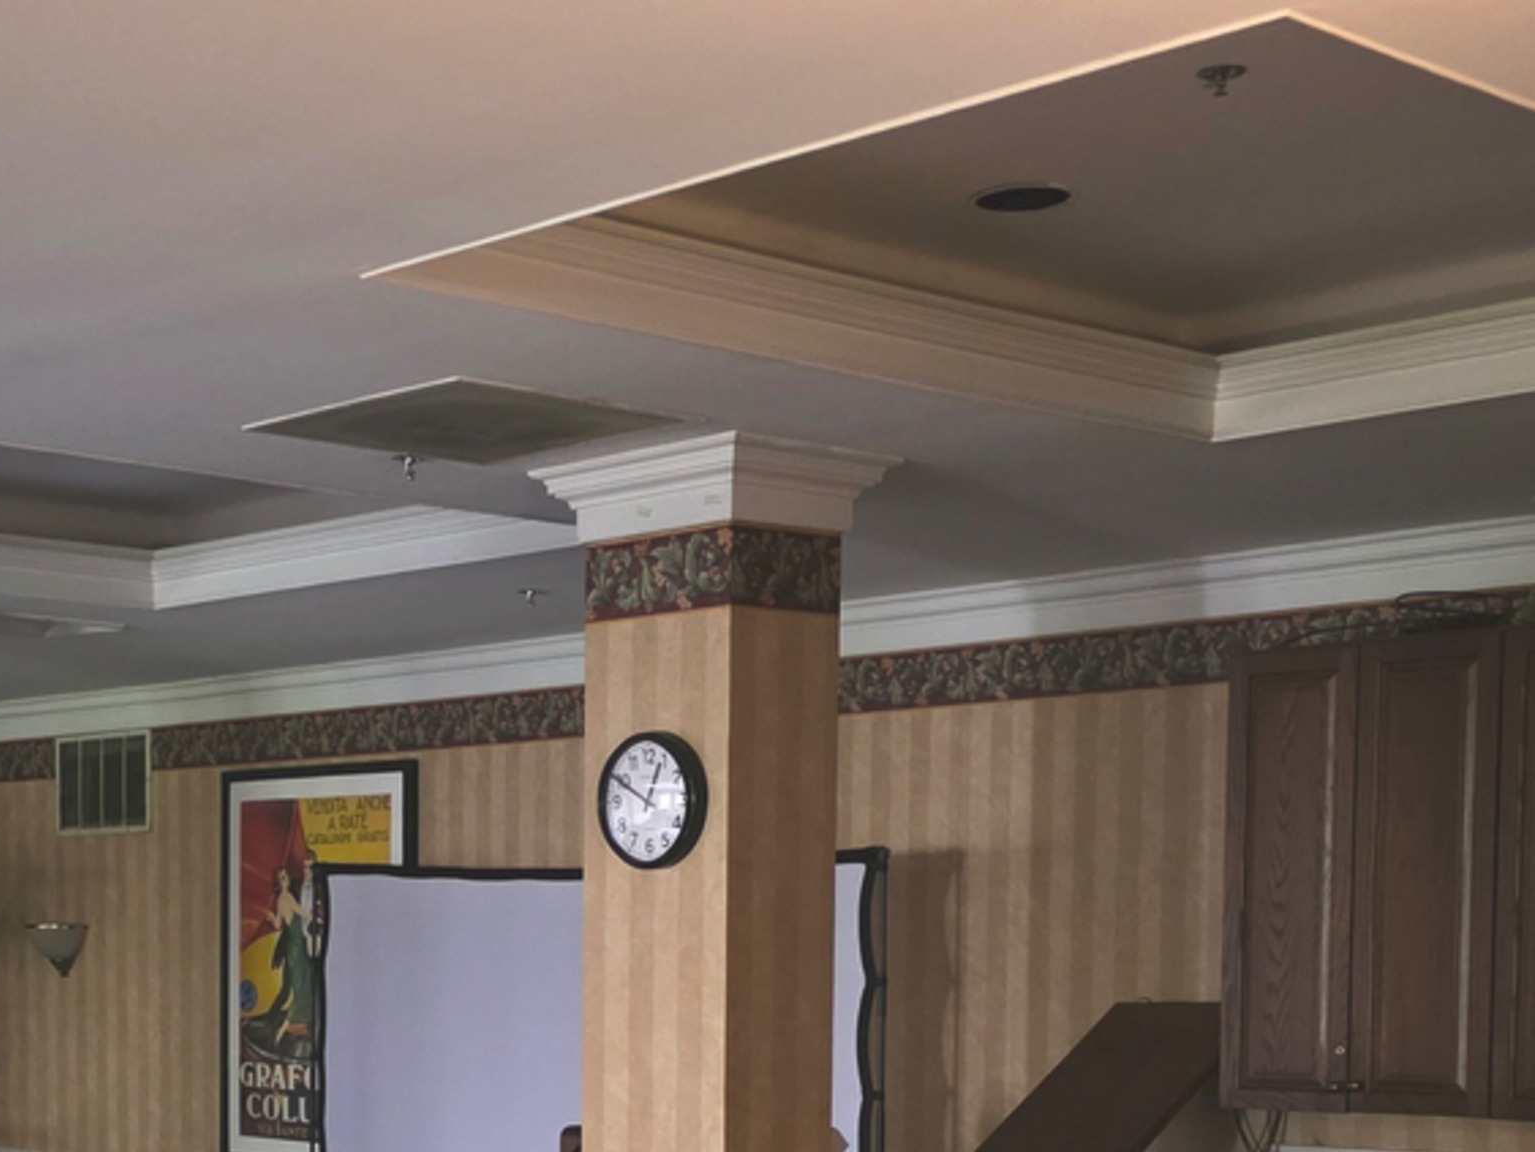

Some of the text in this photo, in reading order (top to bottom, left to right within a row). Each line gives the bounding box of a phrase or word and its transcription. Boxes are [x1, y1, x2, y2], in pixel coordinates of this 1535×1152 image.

[642, 748, 656, 765] 12
[612, 794, 622, 810] 9
[617, 818, 627, 834] 8
[672, 814, 681, 829] 4
[630, 832, 638, 848] 7
[644, 838, 655, 853] 6
[661, 832, 669, 848] 5
